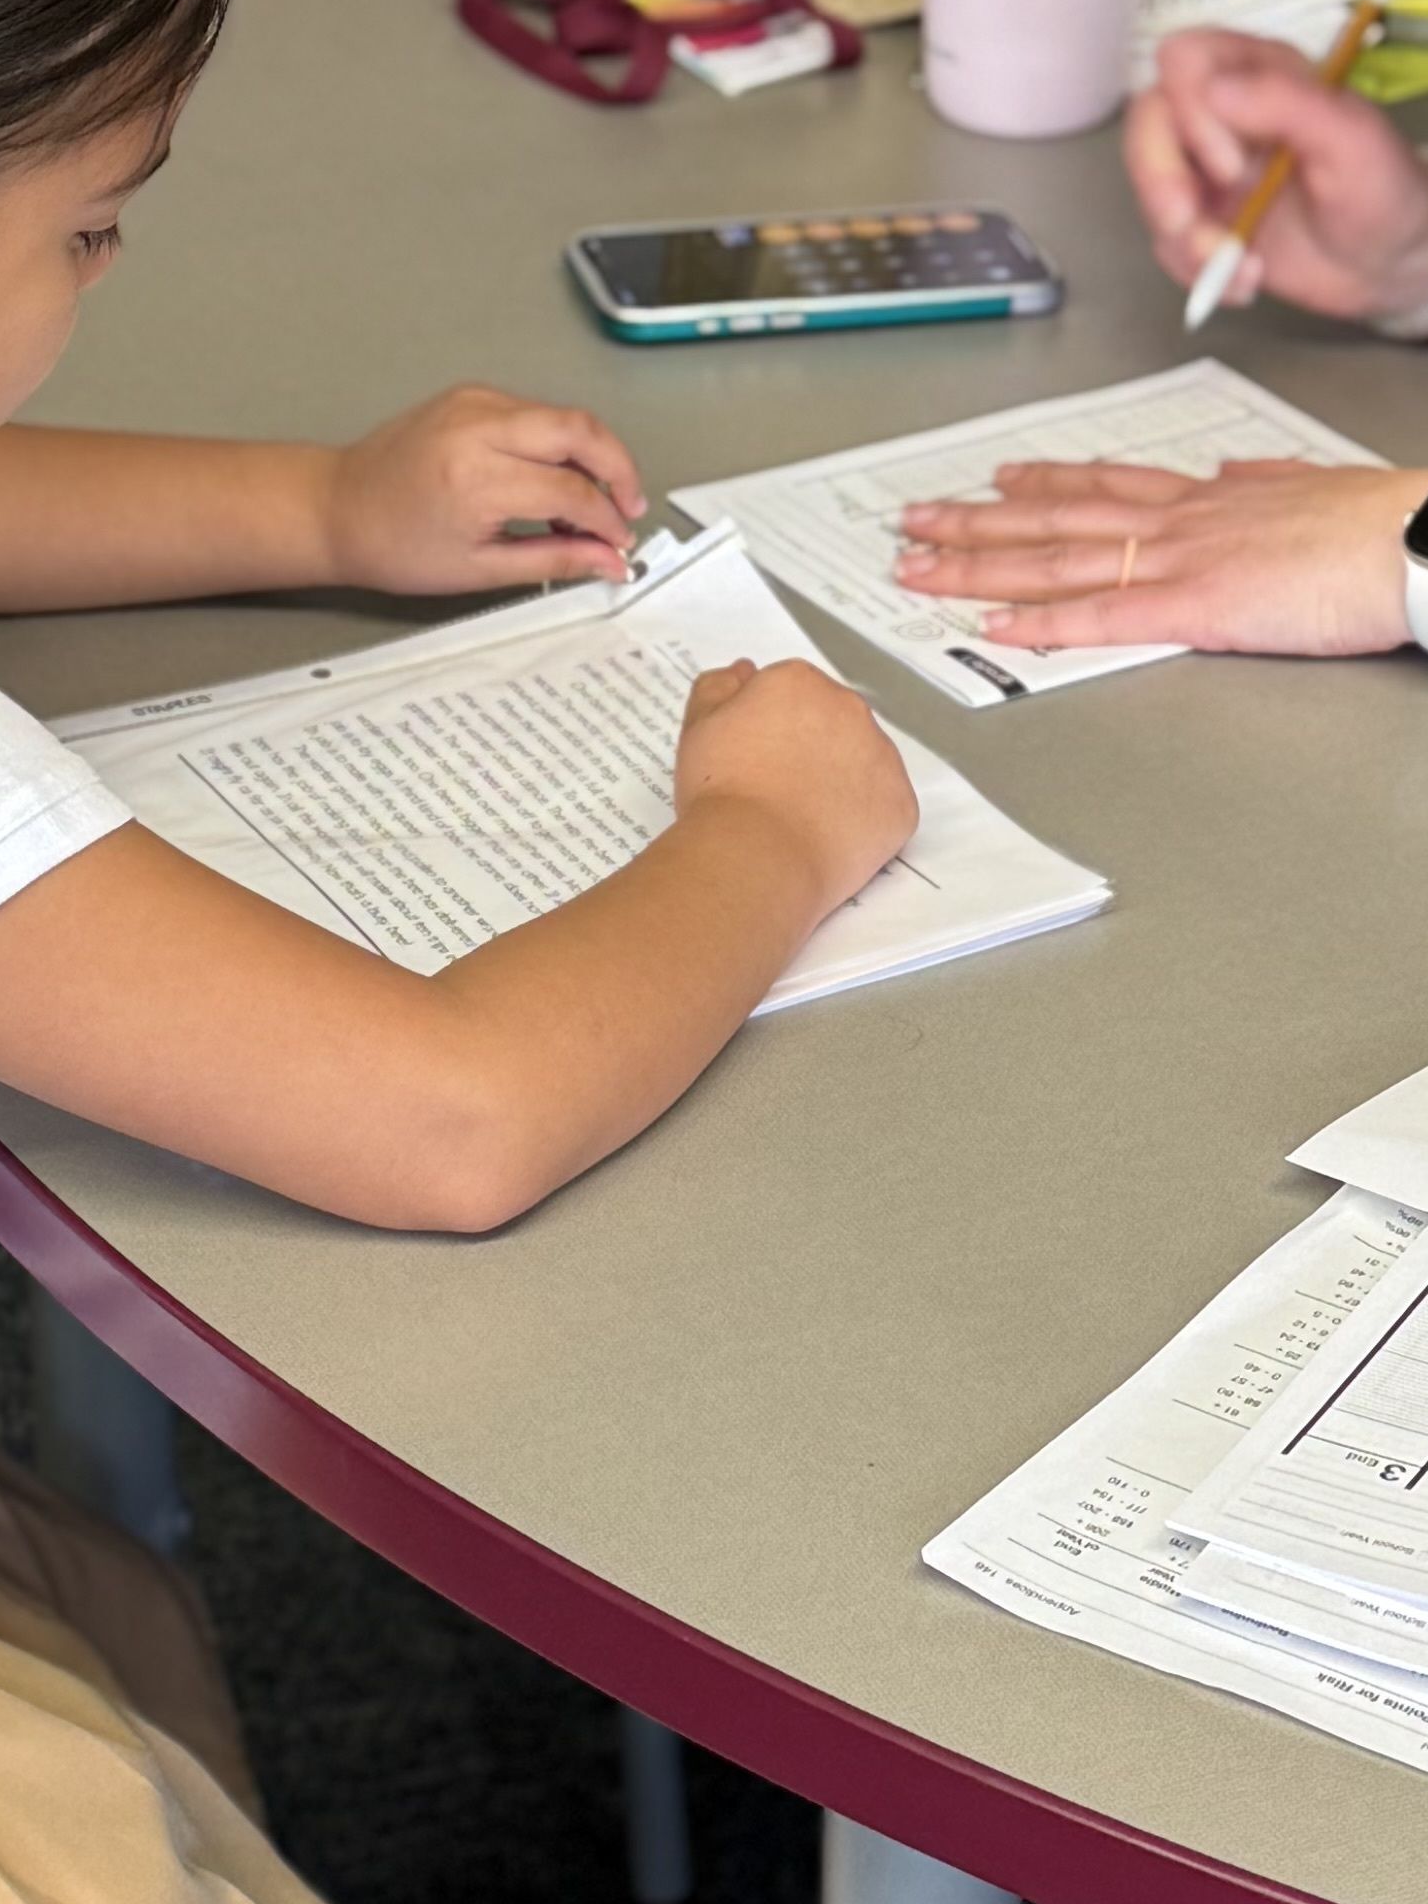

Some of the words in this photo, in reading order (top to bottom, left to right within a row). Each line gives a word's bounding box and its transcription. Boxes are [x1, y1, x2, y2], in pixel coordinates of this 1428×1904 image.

[132, 694, 212, 717] STAPLES
[1345, 1451, 1379, 1467] End
[1379, 1464, 1406, 1482] 3
[1077, 1501, 1103, 1515] 207
[1056, 1529, 1082, 1546] Year
[1053, 1540, 1081, 1556] End
[1005, 1578, 1081, 1616] Appendices
[1316, 1672, 1353, 1692] Risk
[1356, 1689, 1380, 1705] for
